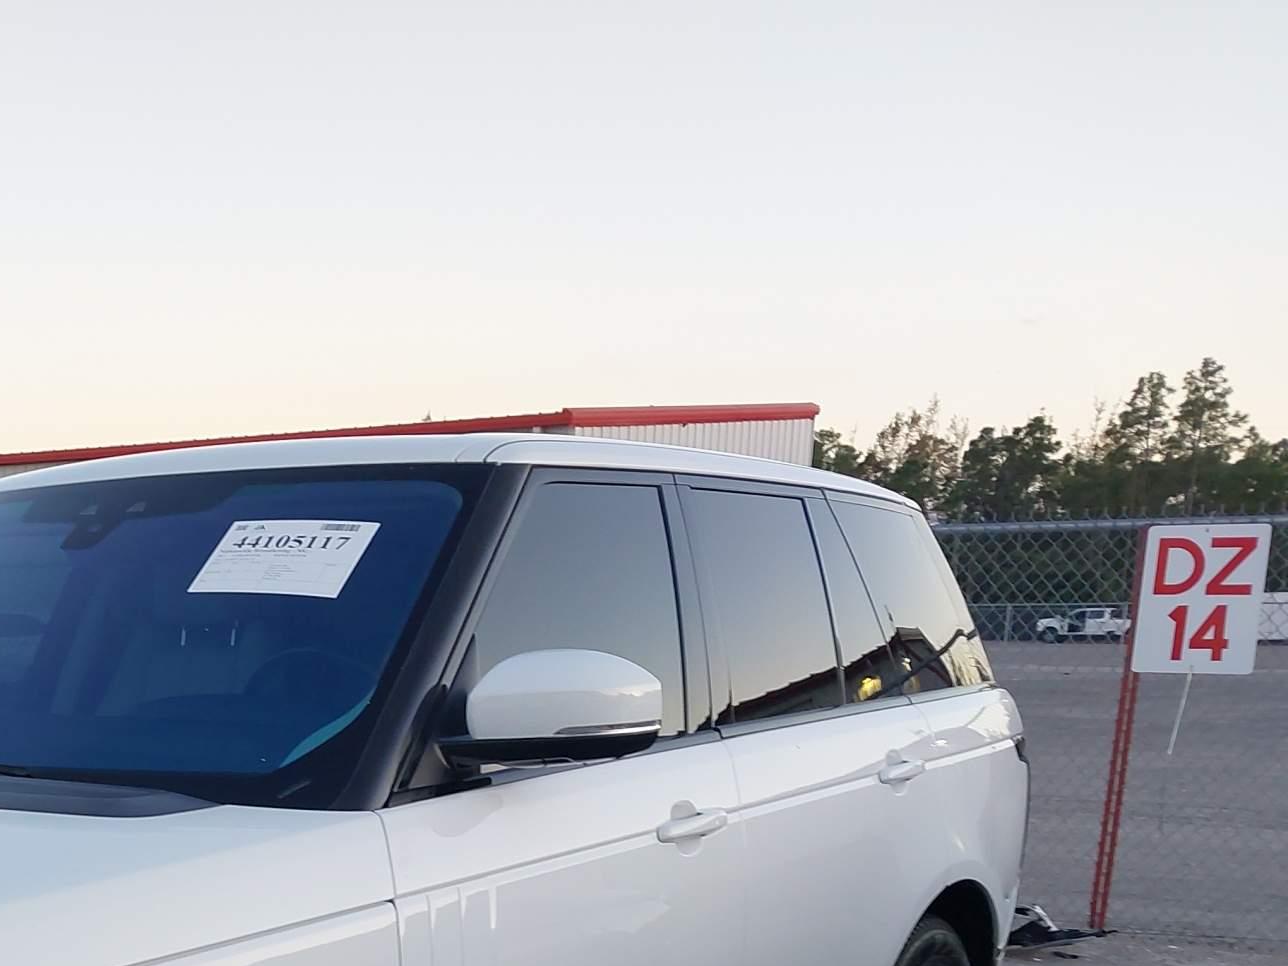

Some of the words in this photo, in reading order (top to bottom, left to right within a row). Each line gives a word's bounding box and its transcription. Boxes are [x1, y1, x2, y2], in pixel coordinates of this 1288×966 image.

[232, 534, 352, 550] 44105117
[1152, 536, 1260, 596] DZ
[1167, 604, 1230, 662] 14
